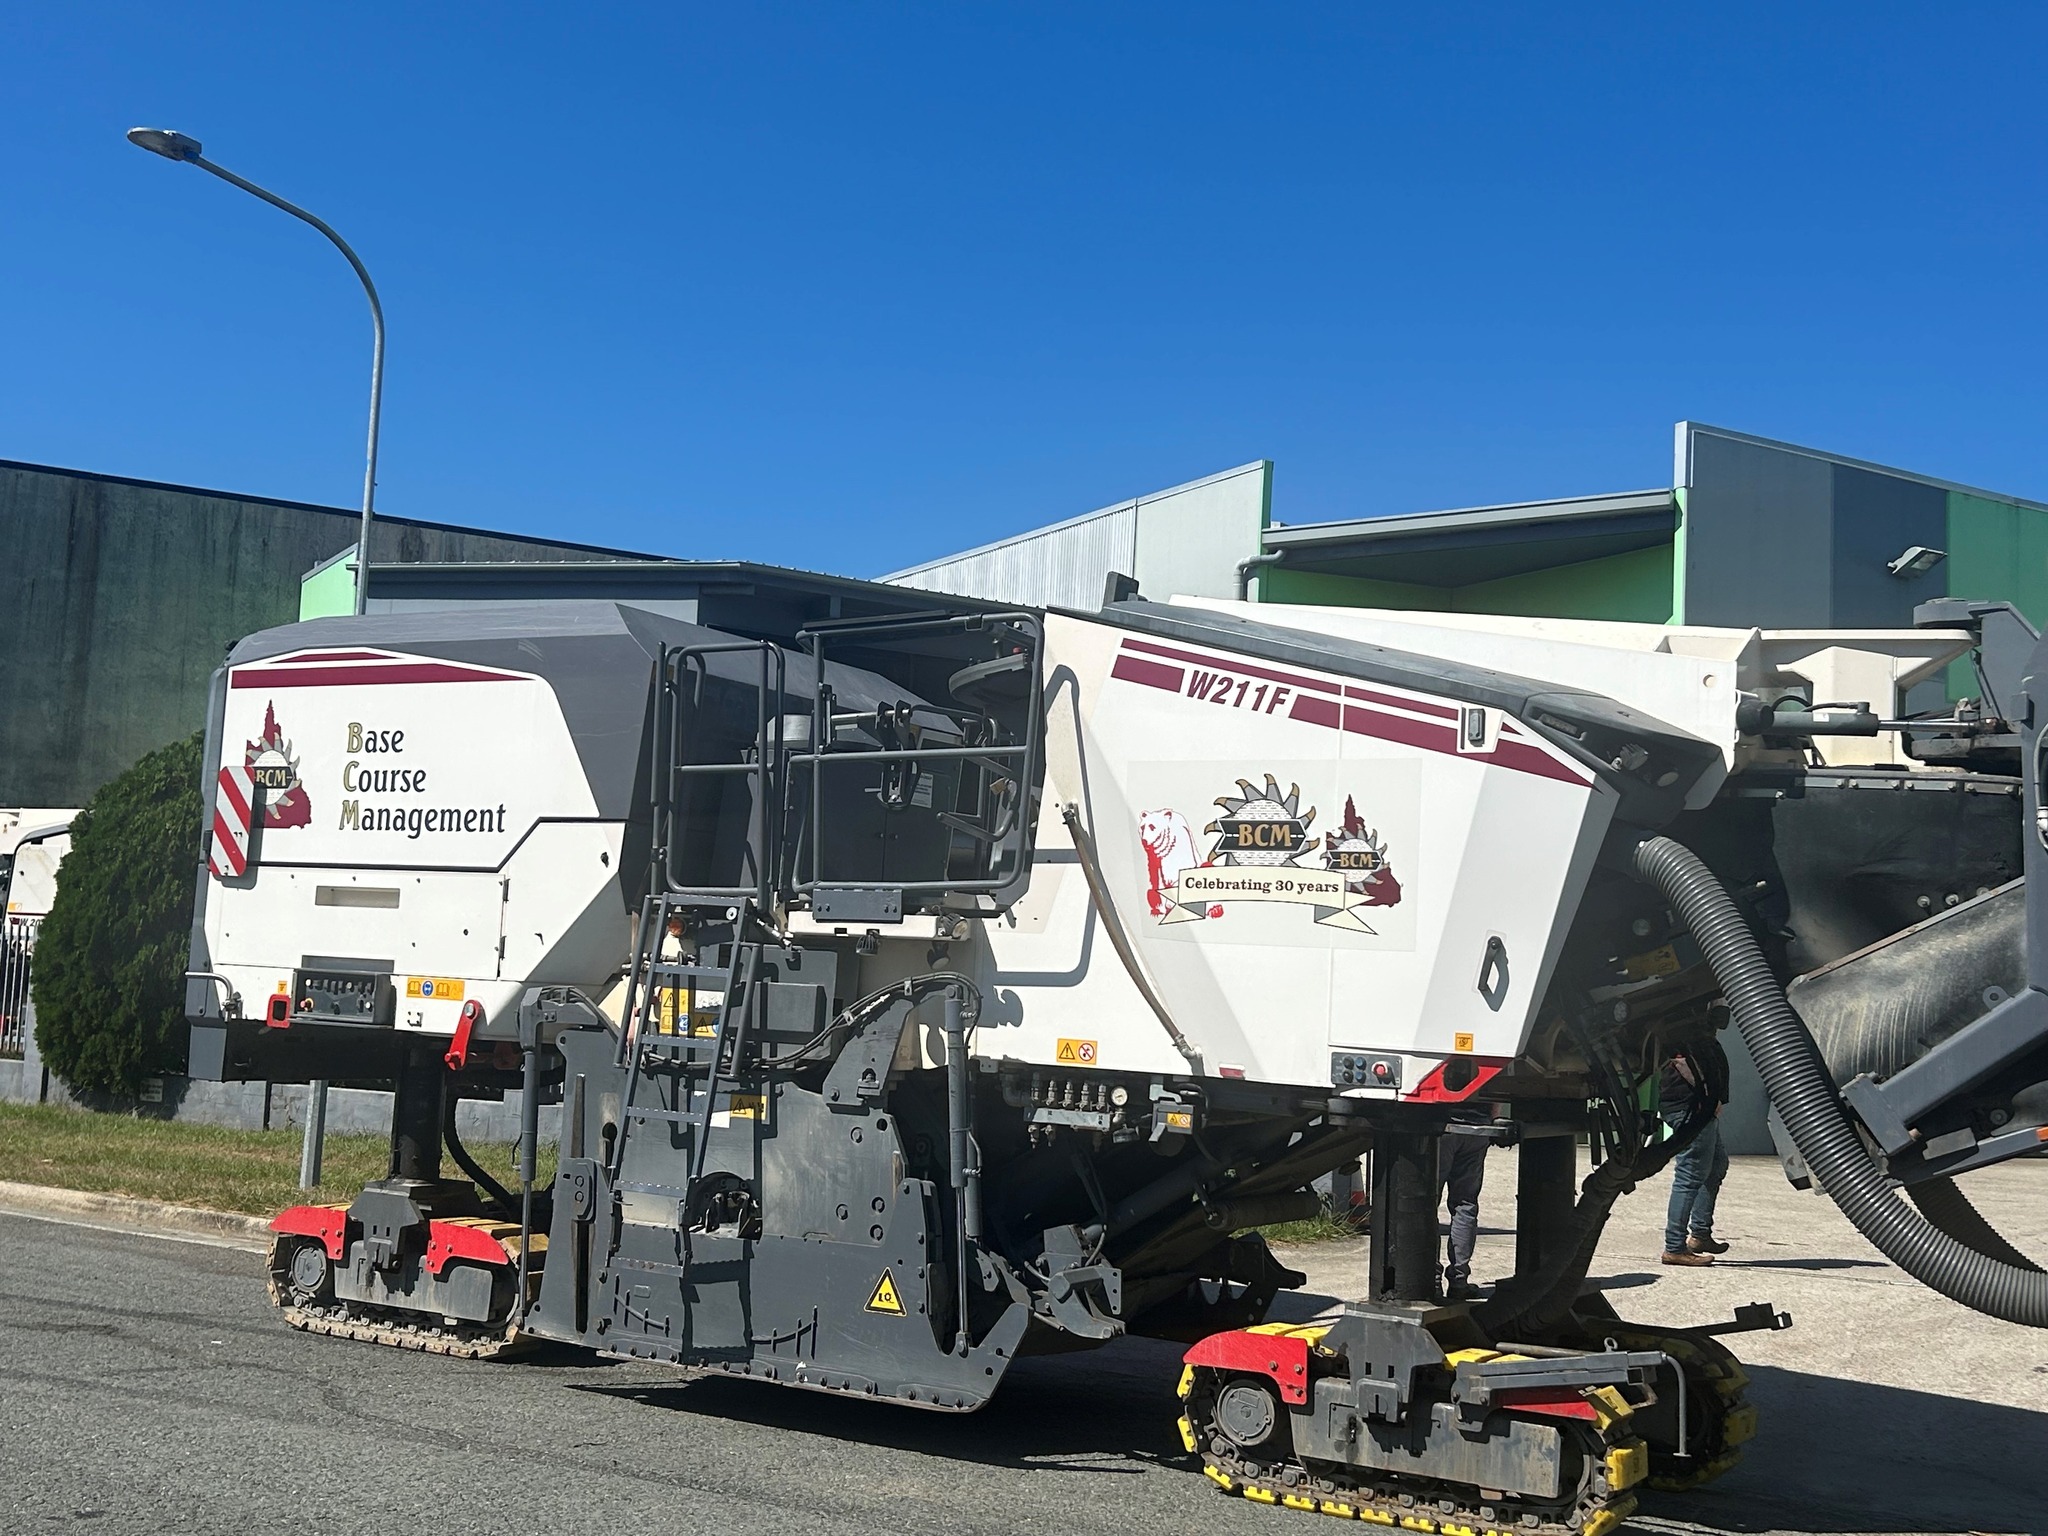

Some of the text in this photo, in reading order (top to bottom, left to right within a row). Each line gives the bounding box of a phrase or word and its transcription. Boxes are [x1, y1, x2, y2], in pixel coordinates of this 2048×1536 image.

[1186, 670, 1290, 716] W211F
[346, 722, 405, 754] Base
[343, 761, 427, 793] Course
[338, 800, 506, 839] Management
[1238, 823, 1292, 848] BCM
[1339, 852, 1373, 869] BCM
[1185, 877, 1339, 895] Celebrating 30 years
